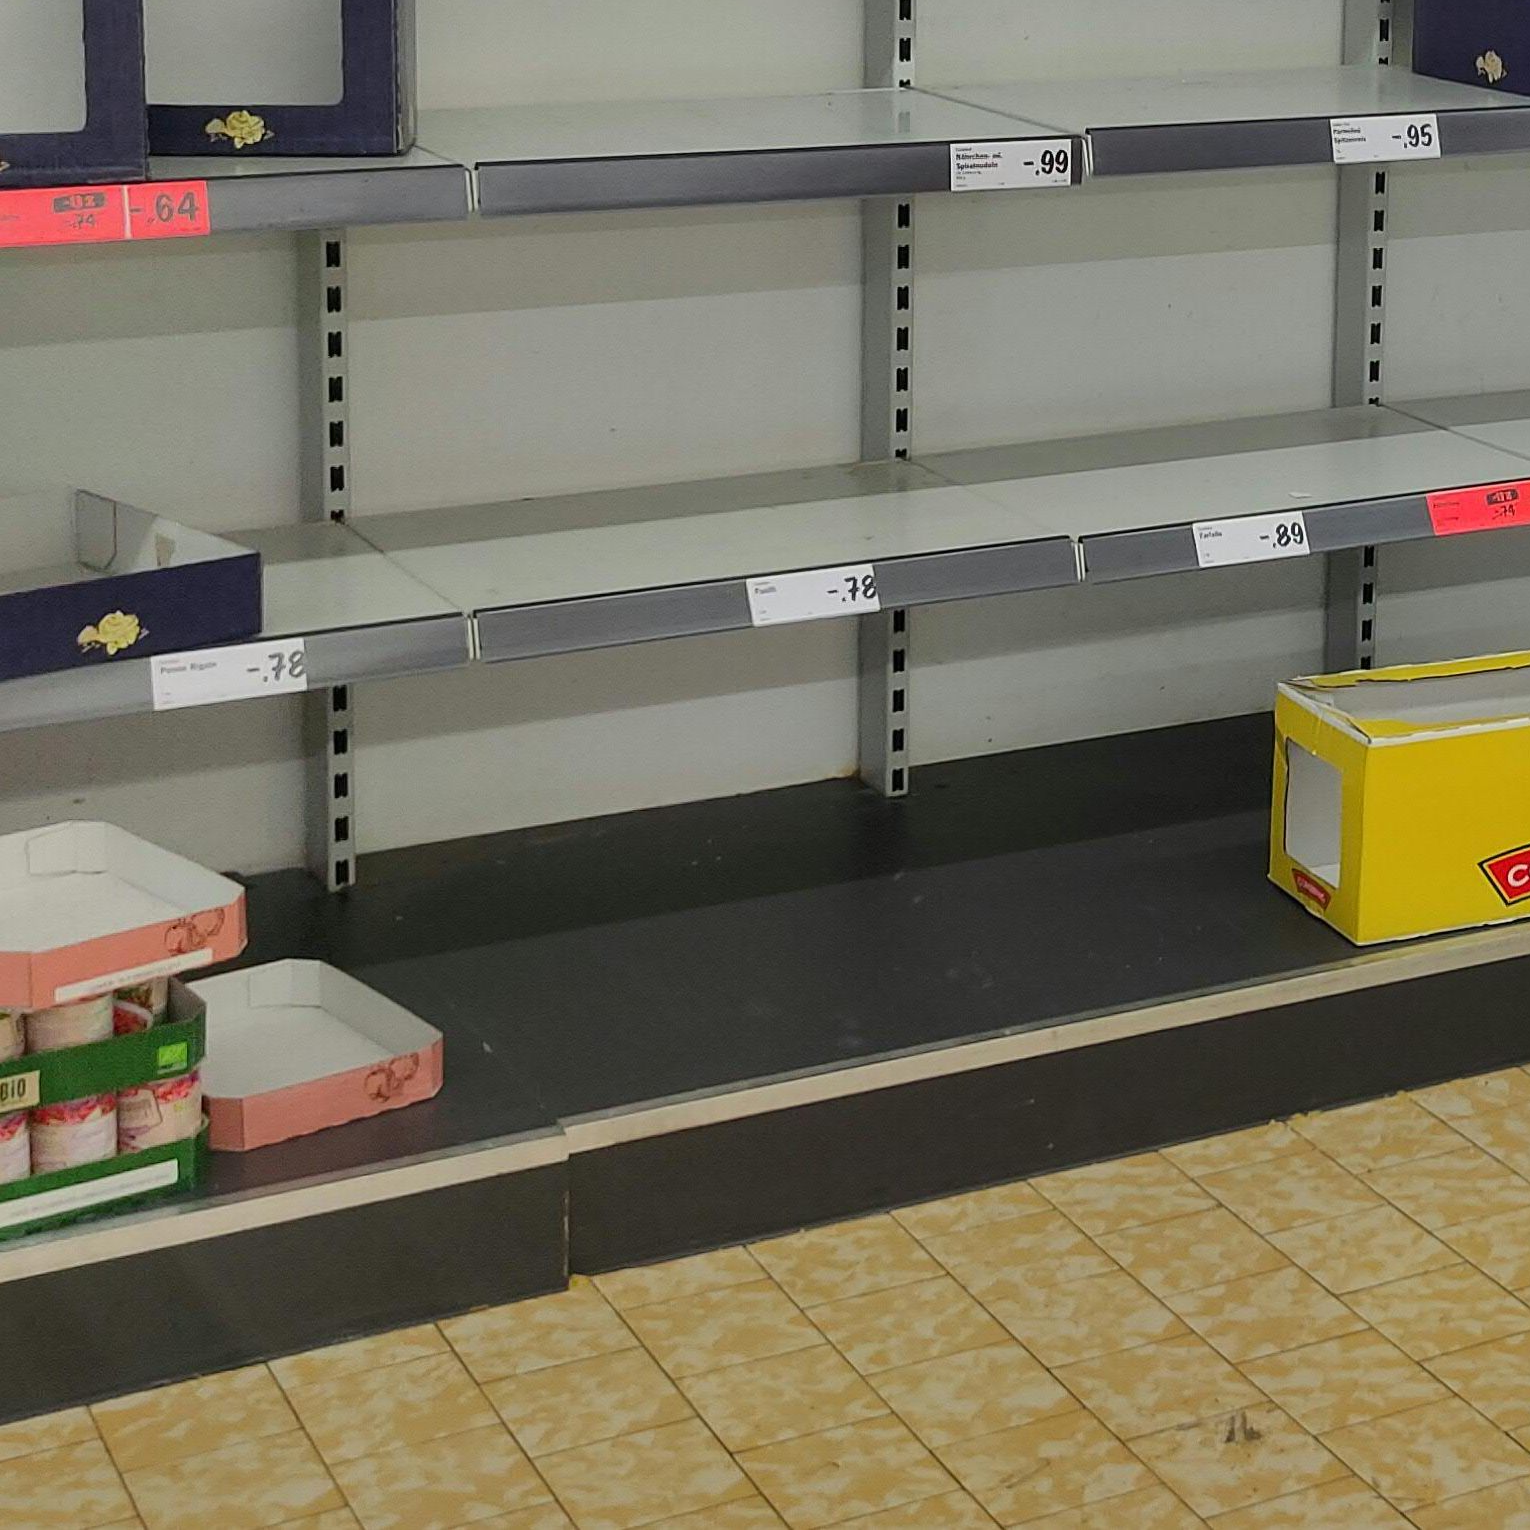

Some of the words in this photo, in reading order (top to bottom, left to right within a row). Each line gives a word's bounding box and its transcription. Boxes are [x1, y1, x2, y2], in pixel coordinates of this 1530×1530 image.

[1392, 124, 1432, 148] -.95
[1024, 150, 1068, 175] -.99
[1260, 522, 1303, 548] -.89
[827, 575, 876, 601] -.78
[247, 651, 306, 683] -.78
